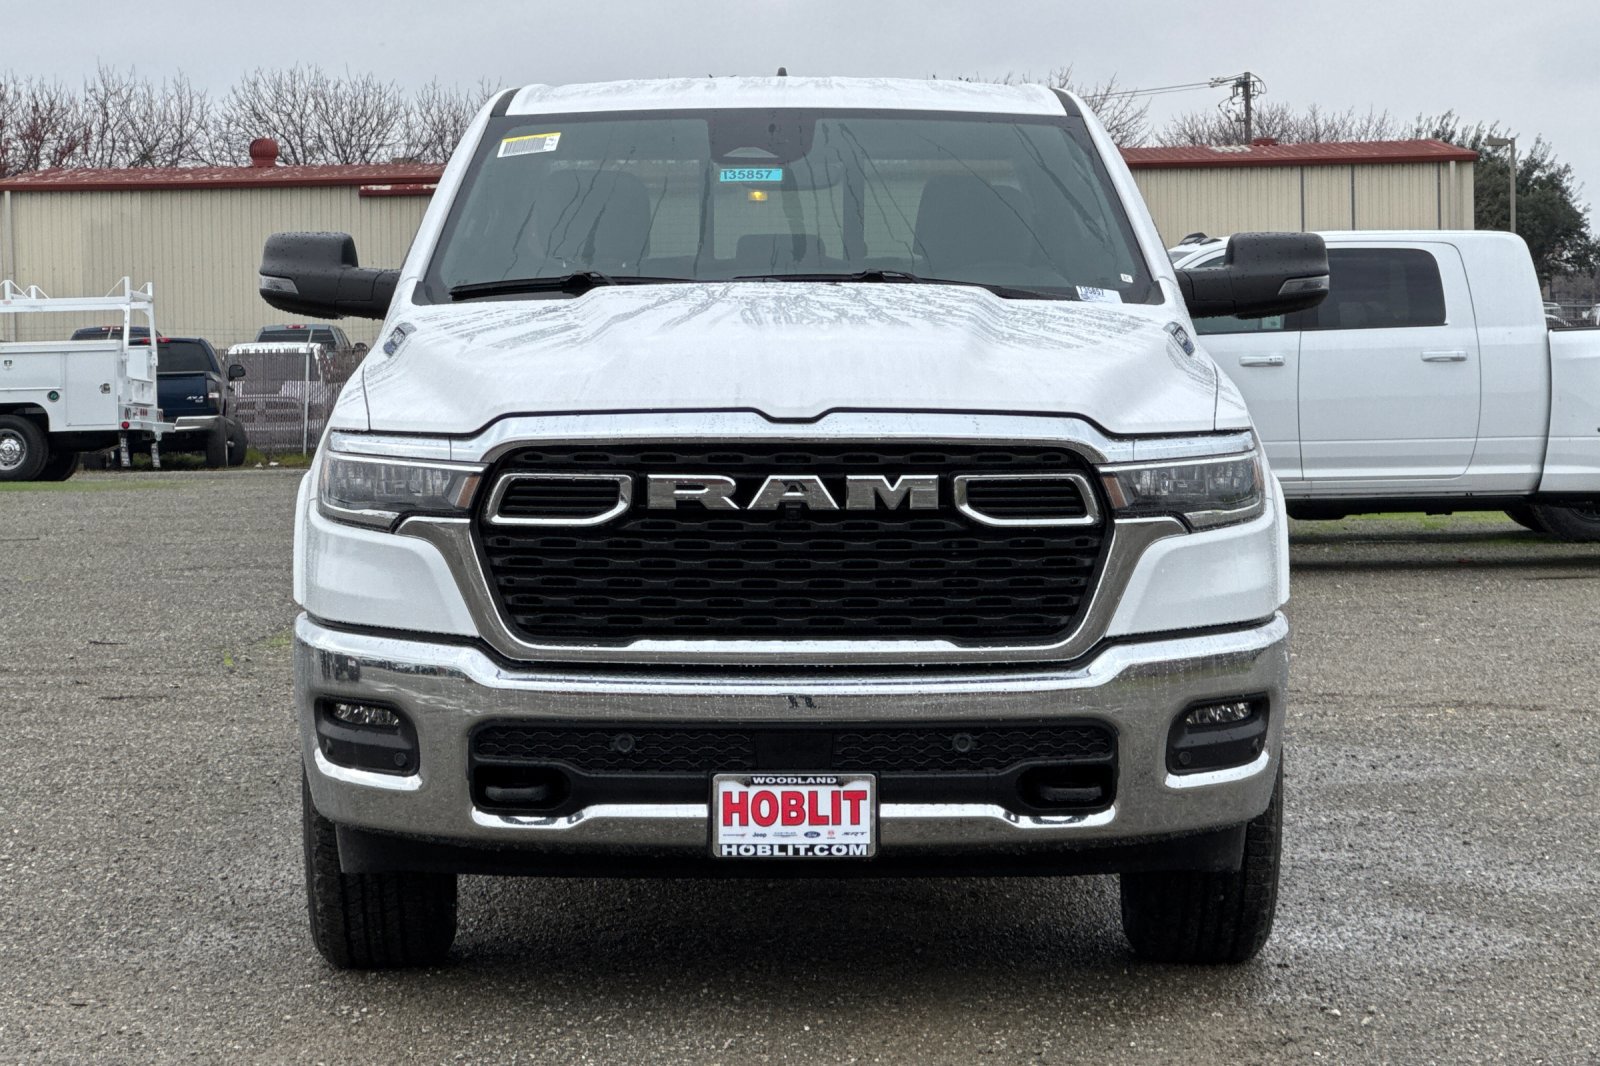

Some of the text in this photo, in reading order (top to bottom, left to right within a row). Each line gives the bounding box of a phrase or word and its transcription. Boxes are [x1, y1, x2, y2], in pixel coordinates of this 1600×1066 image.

[647, 474, 939, 510] RAM
[722, 790, 868, 827] HOBLIT
[721, 844, 867, 856] HOBLIT.COM
